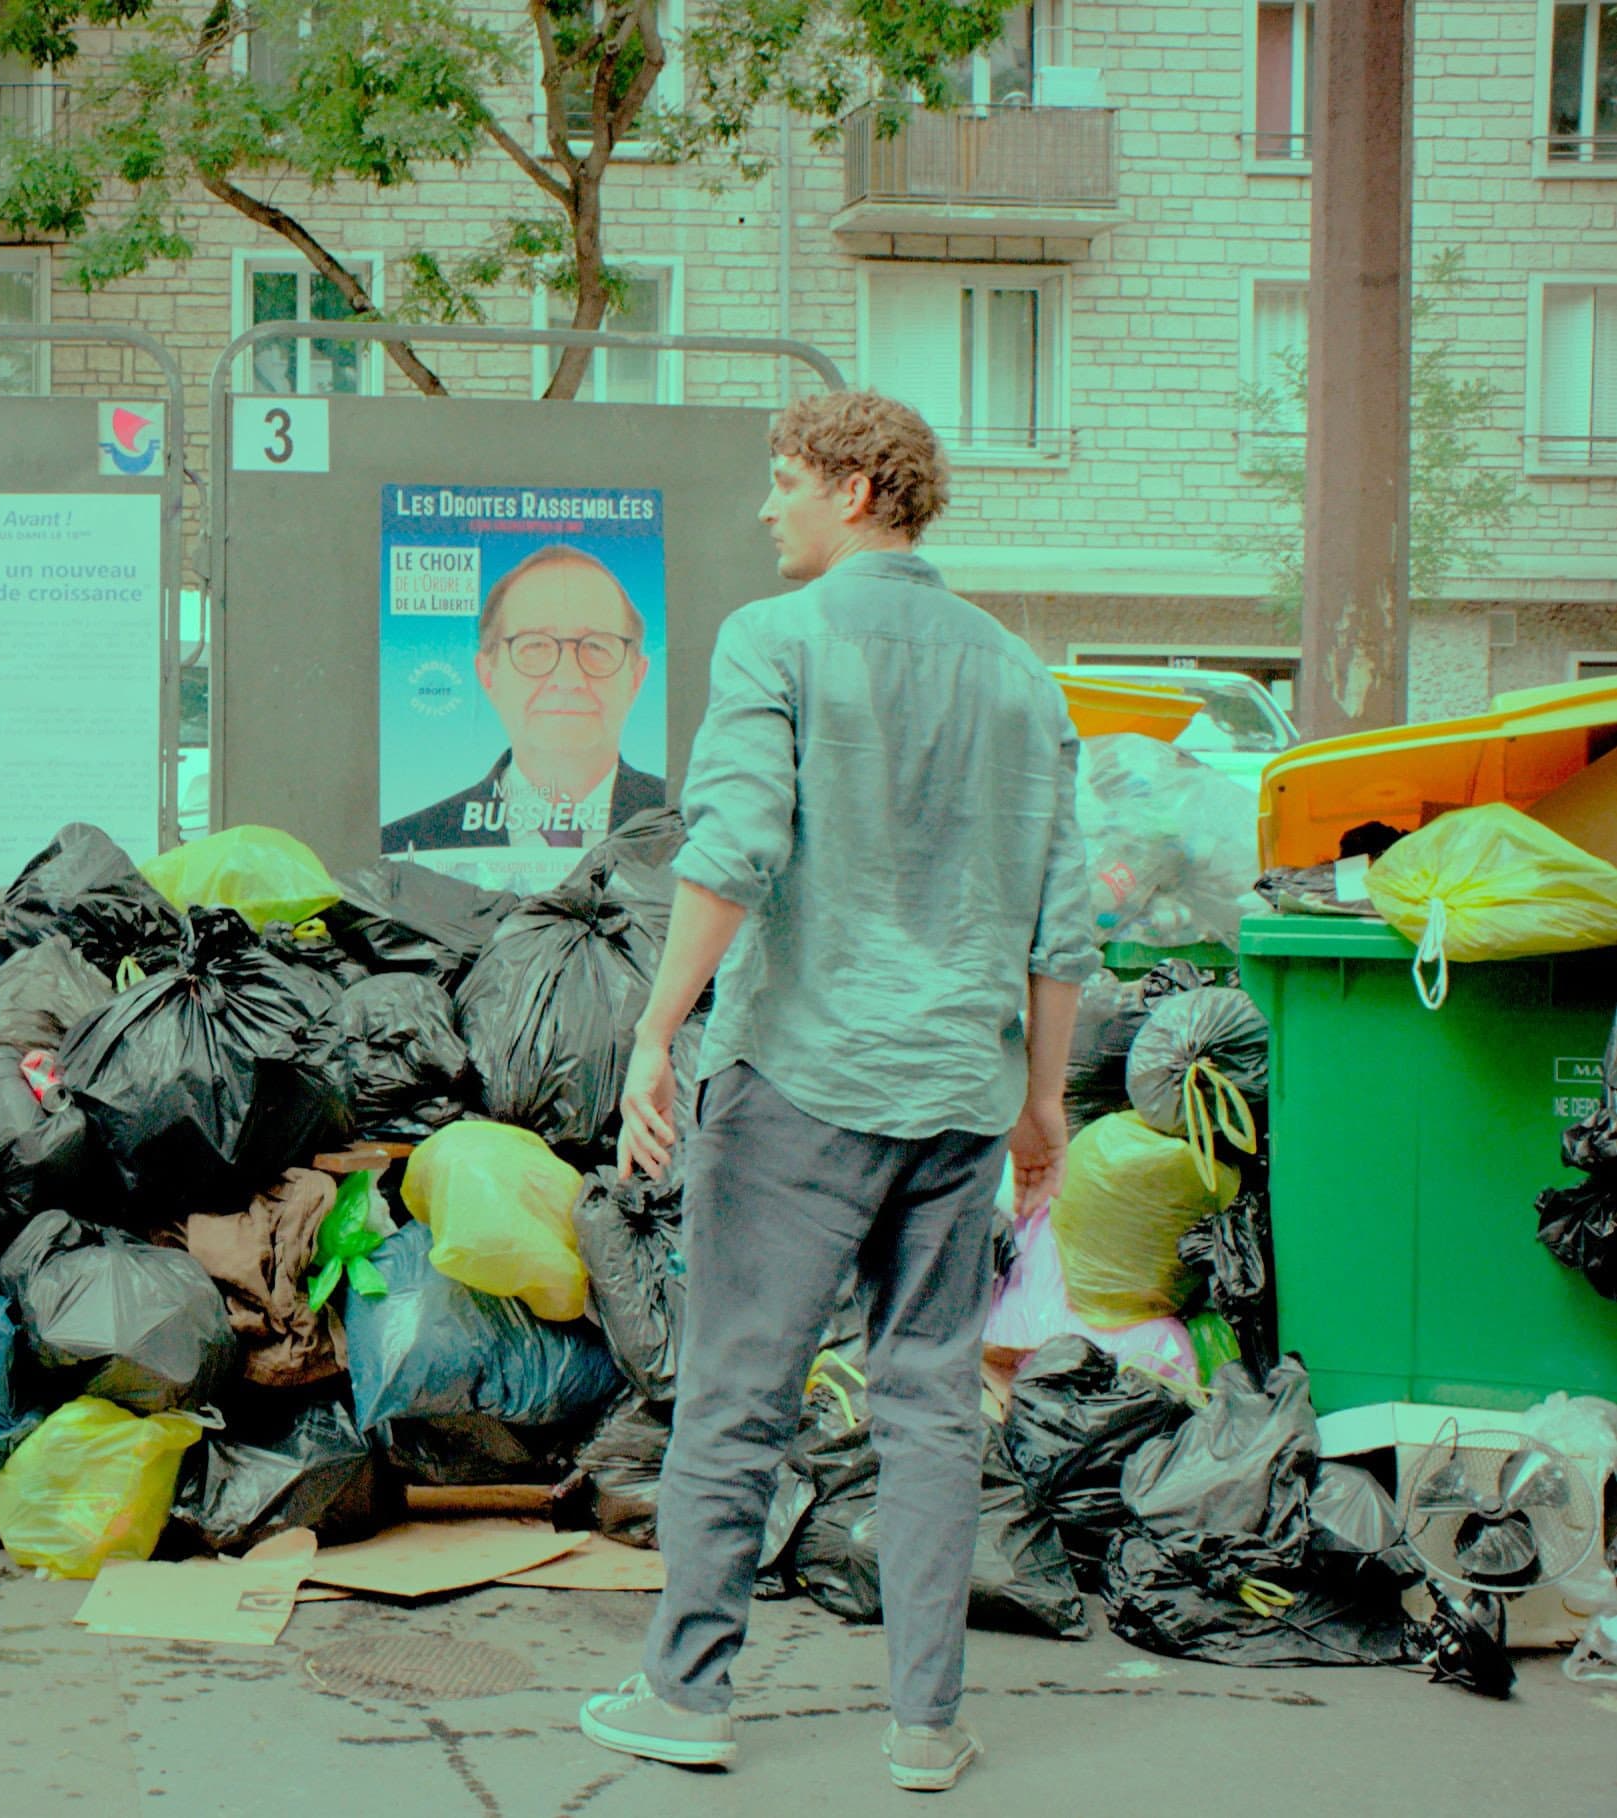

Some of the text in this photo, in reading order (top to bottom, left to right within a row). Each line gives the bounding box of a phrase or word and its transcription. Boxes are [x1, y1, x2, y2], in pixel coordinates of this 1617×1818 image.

[264, 409, 294, 463] 3
[397, 489, 654, 519] LES DROITES RASSEMBLÉES
[3, 511, 61, 528] Avant
[5, 564, 33, 579] un
[40, 563, 137, 578] nouveau
[396, 552, 474, 572] LE CHOIX
[395, 576, 409, 592] DE
[395, 598, 409, 610] DE
[413, 598, 427, 610] LA
[461, 793, 610, 832] BUSSIÈRE
[1553, 1097, 1568, 1116] NE
